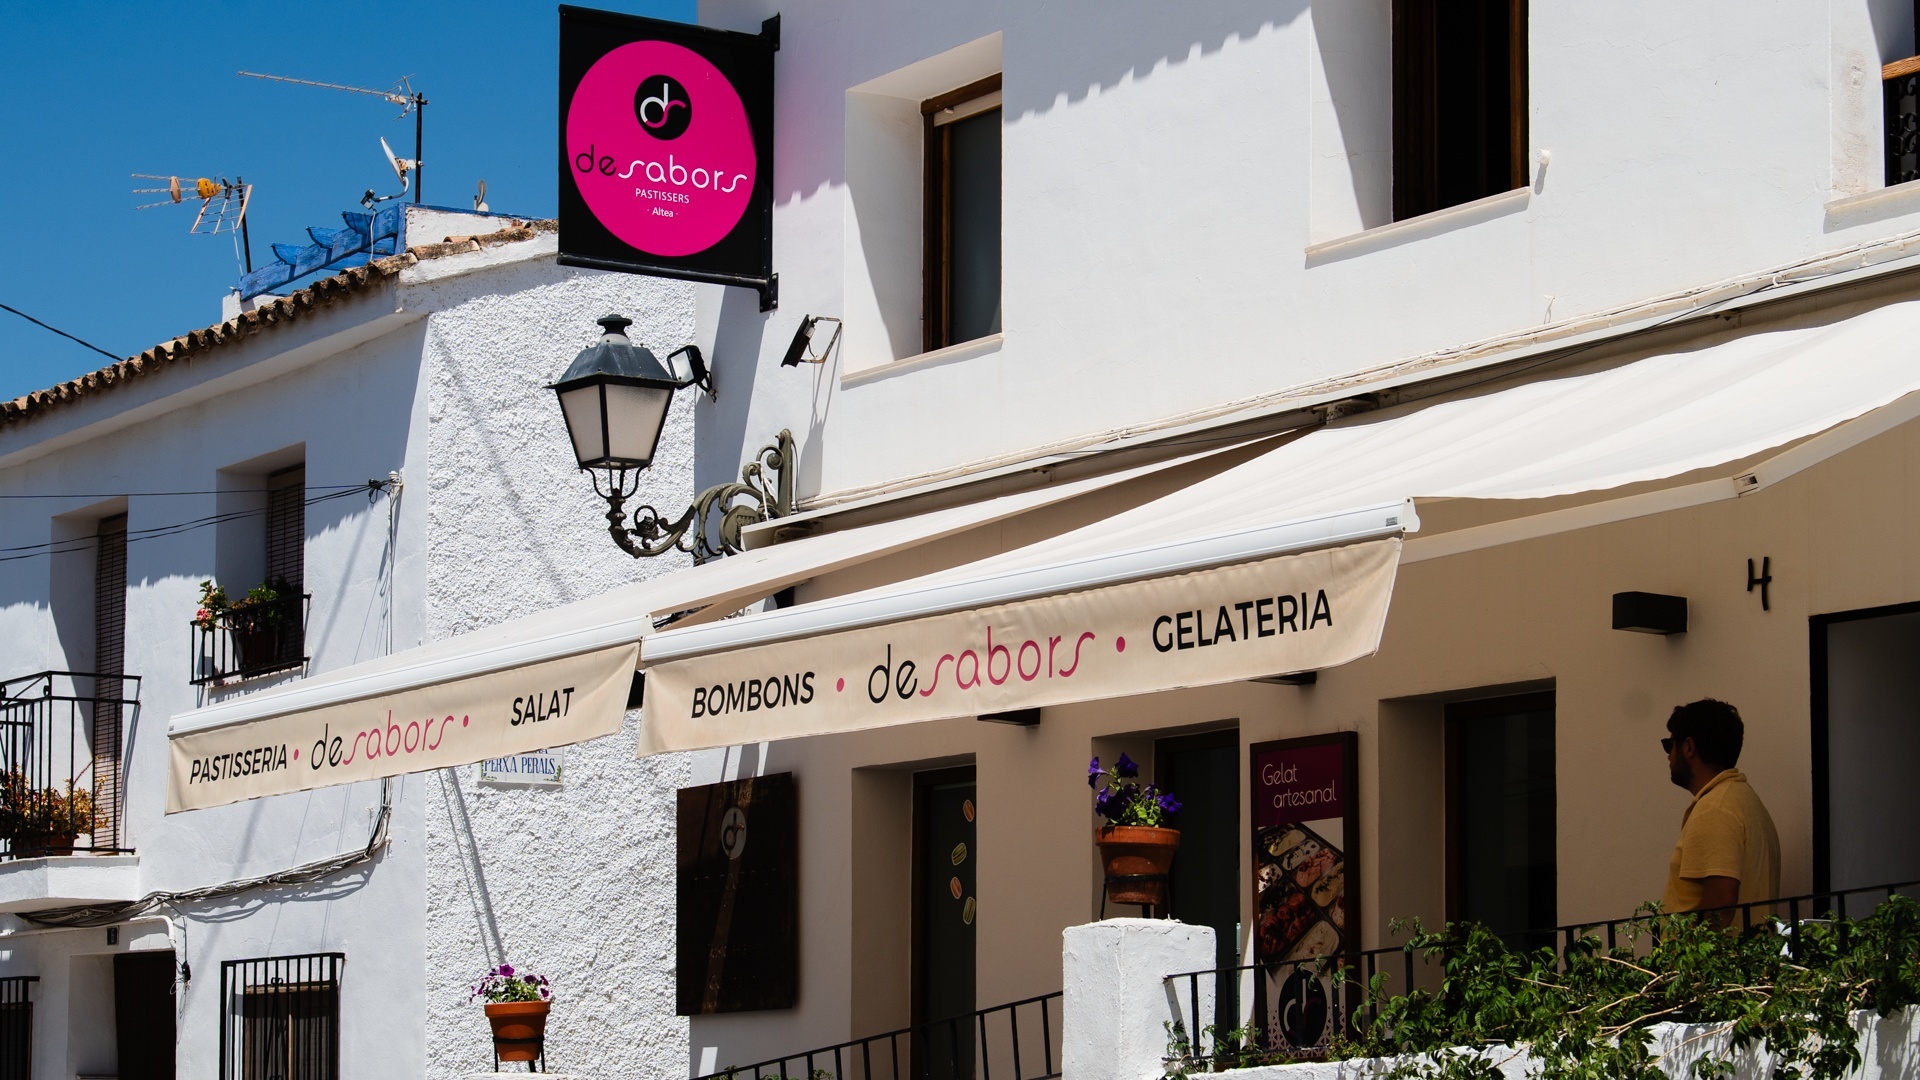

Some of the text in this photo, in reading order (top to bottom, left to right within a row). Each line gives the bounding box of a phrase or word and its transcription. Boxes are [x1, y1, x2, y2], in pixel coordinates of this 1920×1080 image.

[635, 187, 690, 204] PASTISSERS
[652, 206, 674, 218] Altea
[1747, 556, 1772, 611] 4
[691, 671, 816, 719] BOMBONS
[1152, 588, 1333, 653] GELATERIA
[189, 743, 287, 785] PASTISSERIA
[510, 686, 575, 727] SALAT
[521, 757, 556, 775] PERALS
[1262, 763, 1298, 786] Gelat
[1273, 779, 1337, 809] artesanal
